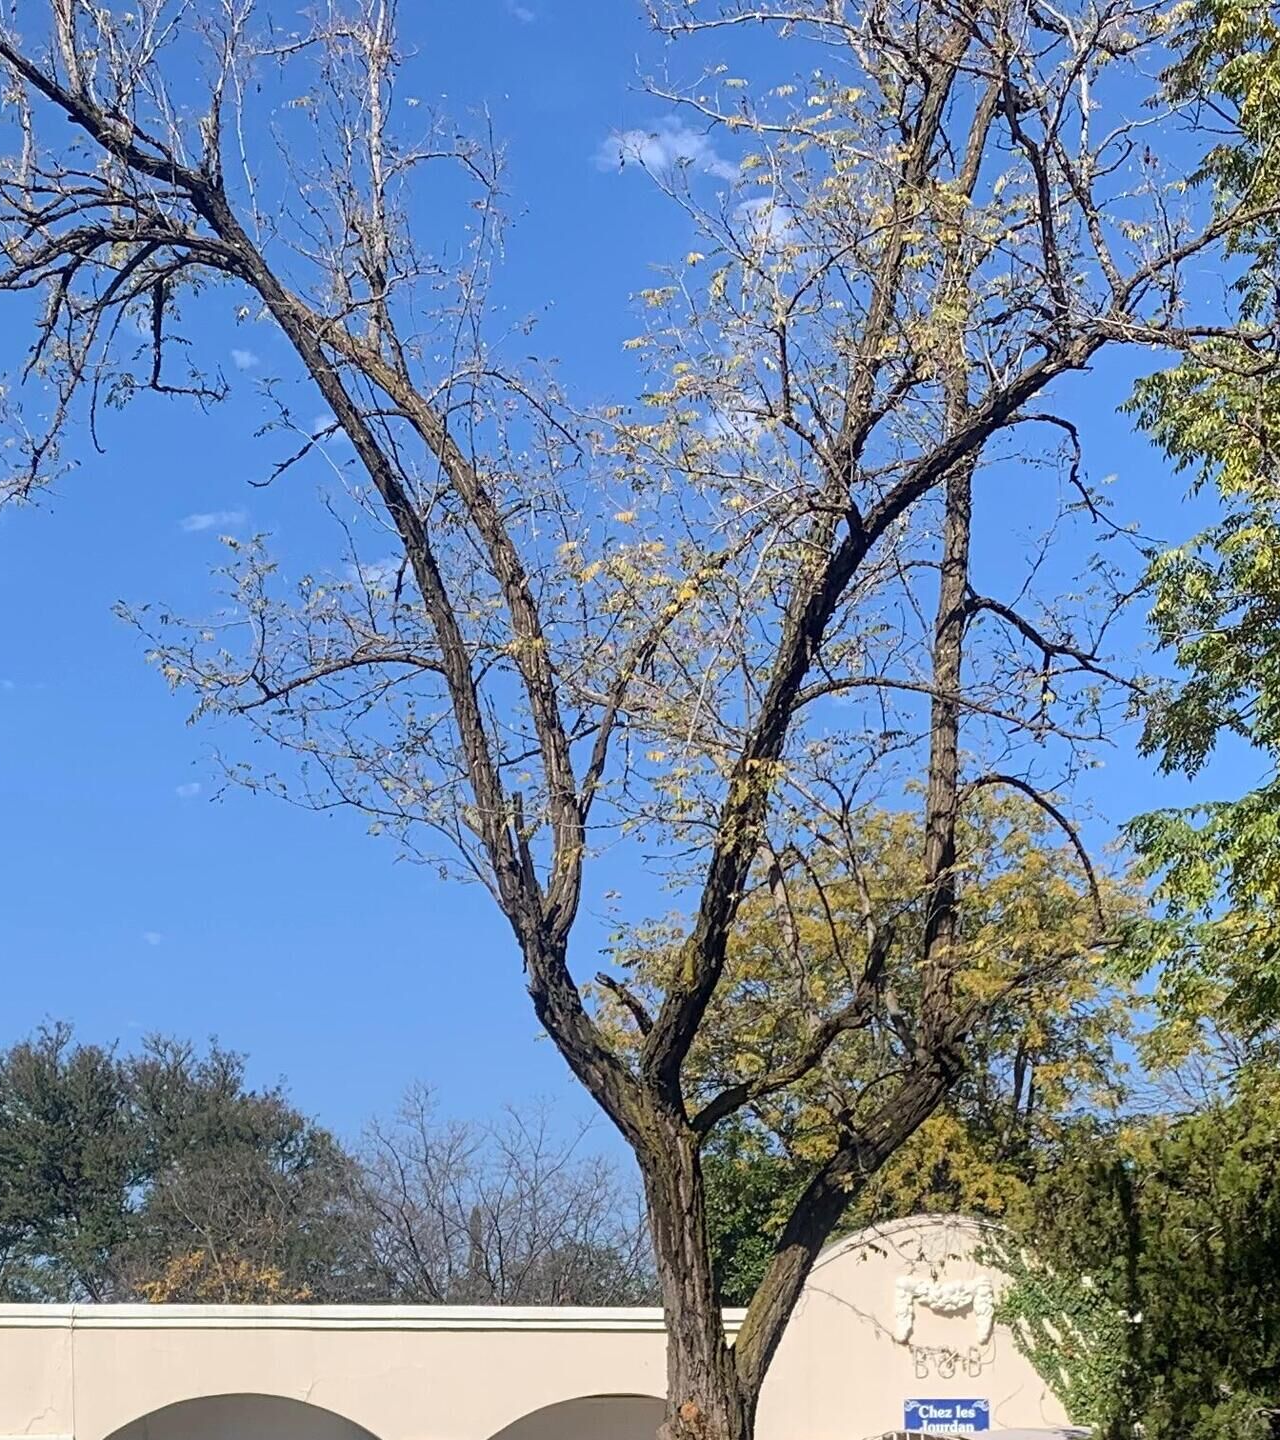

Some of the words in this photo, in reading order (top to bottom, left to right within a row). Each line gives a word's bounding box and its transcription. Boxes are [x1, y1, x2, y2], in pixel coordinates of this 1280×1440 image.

[918, 1404, 953, 1418] Chez
[955, 1404, 977, 1418] les
[921, 1420, 975, 1433] Jourdan
